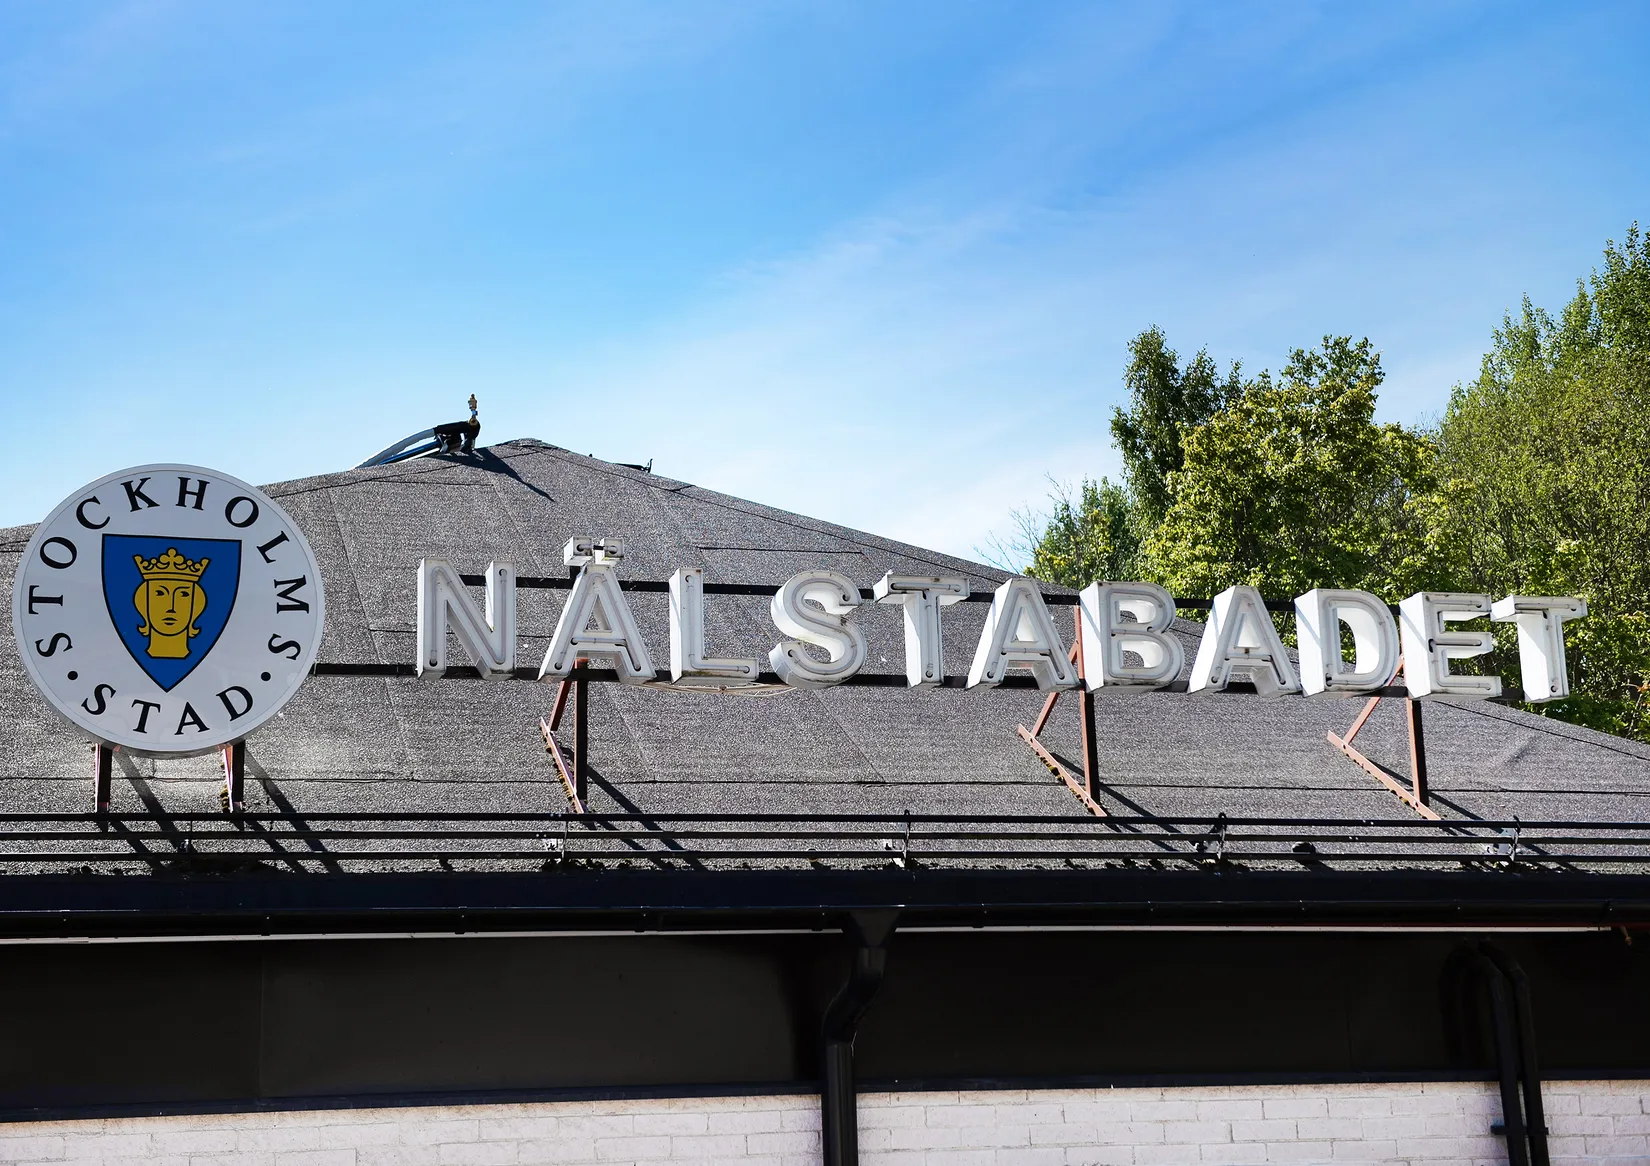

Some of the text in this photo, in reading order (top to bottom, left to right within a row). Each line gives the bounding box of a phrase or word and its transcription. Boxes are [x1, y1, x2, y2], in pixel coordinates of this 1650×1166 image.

[28, 476, 310, 660] STOCKHOLMS
[416, 536, 1589, 704] NÄLSTABADET
[81, 683, 254, 735] STAD
